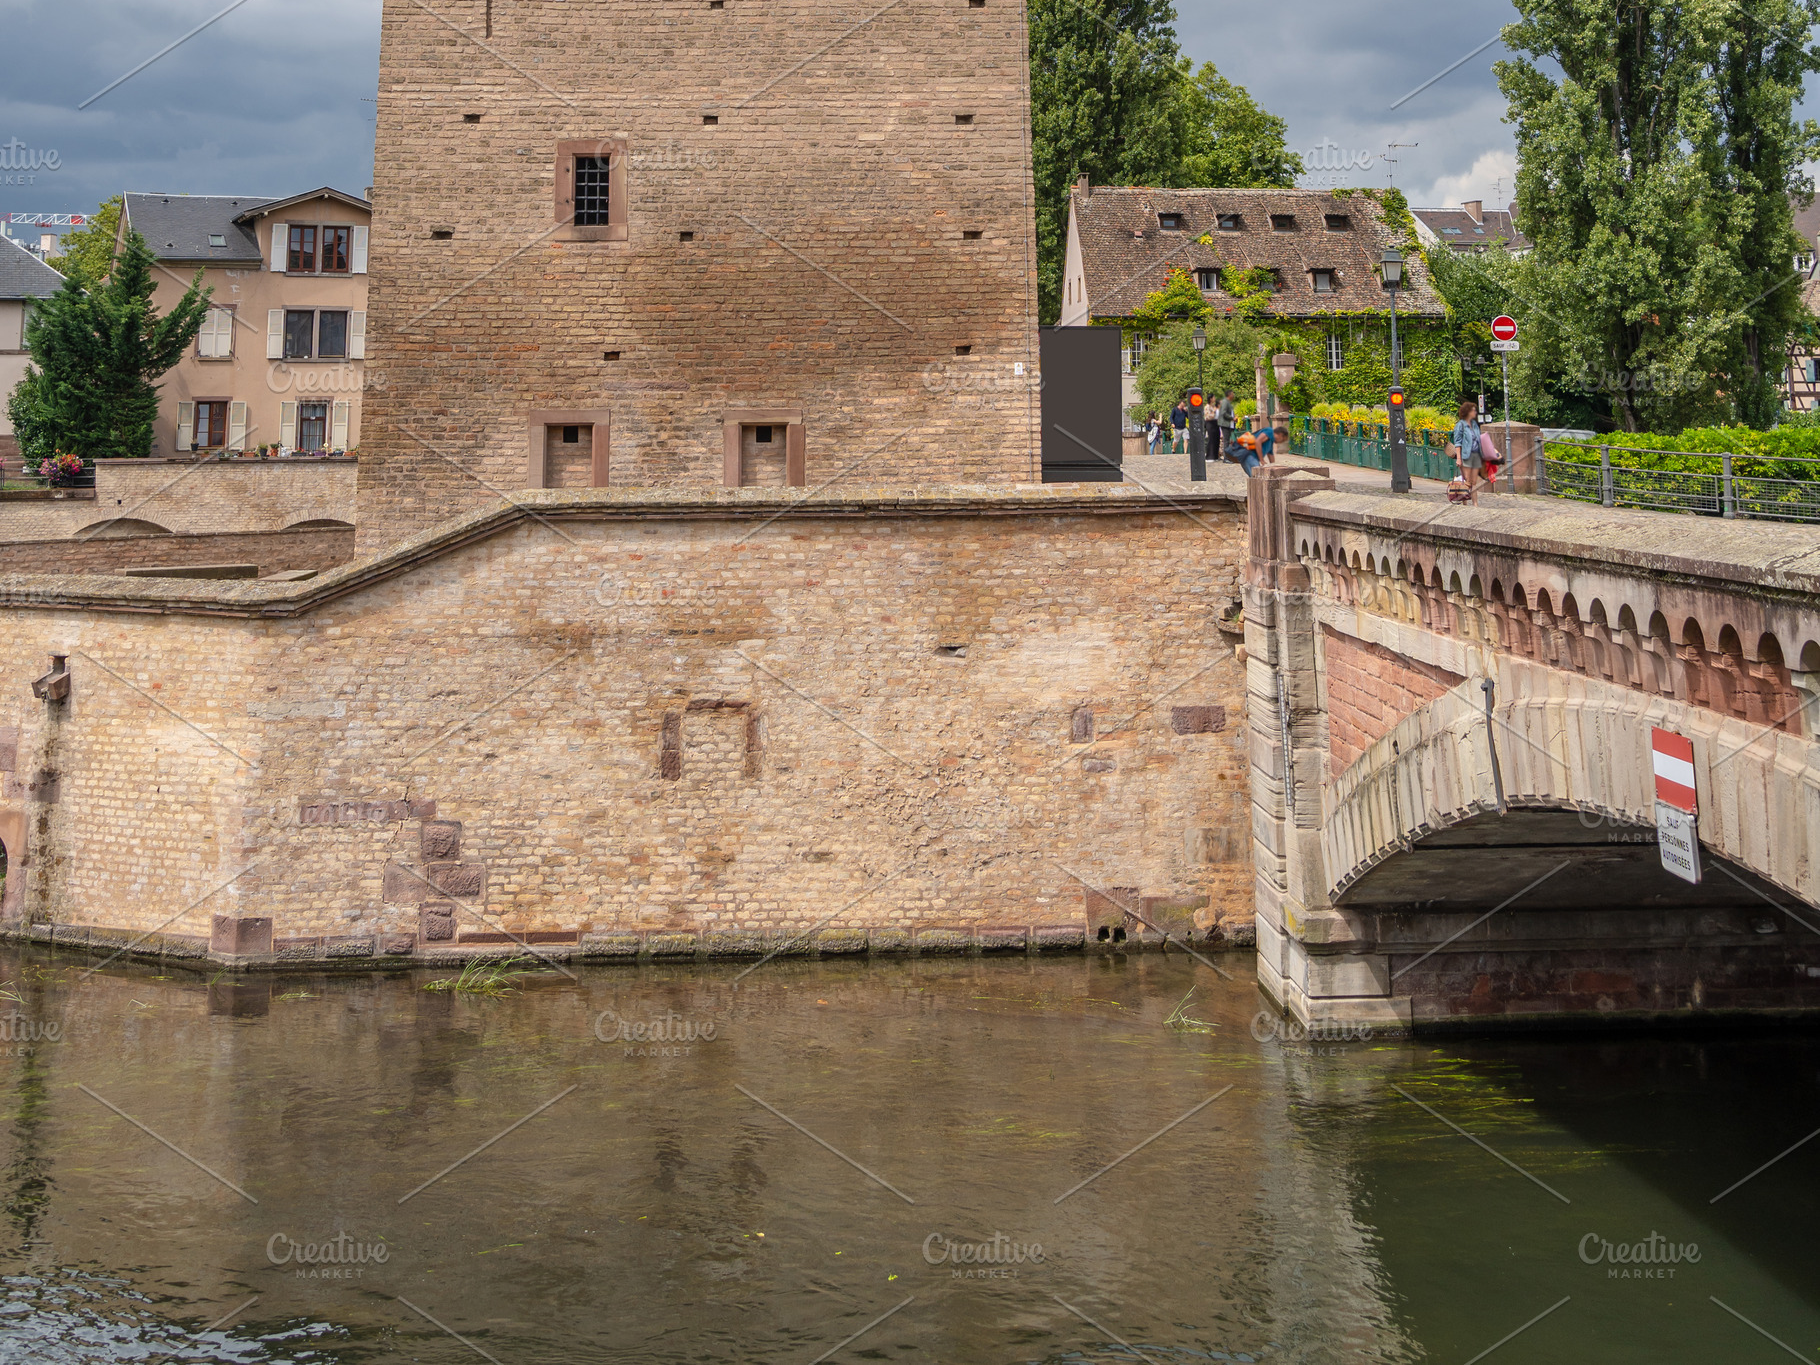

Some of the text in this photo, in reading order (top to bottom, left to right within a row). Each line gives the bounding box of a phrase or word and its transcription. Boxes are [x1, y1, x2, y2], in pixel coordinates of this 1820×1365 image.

[1666, 816, 1679, 829] SAUF
[1661, 831, 1690, 853] PERSONNES
[1662, 848, 1691, 871] AUTORISÉES
